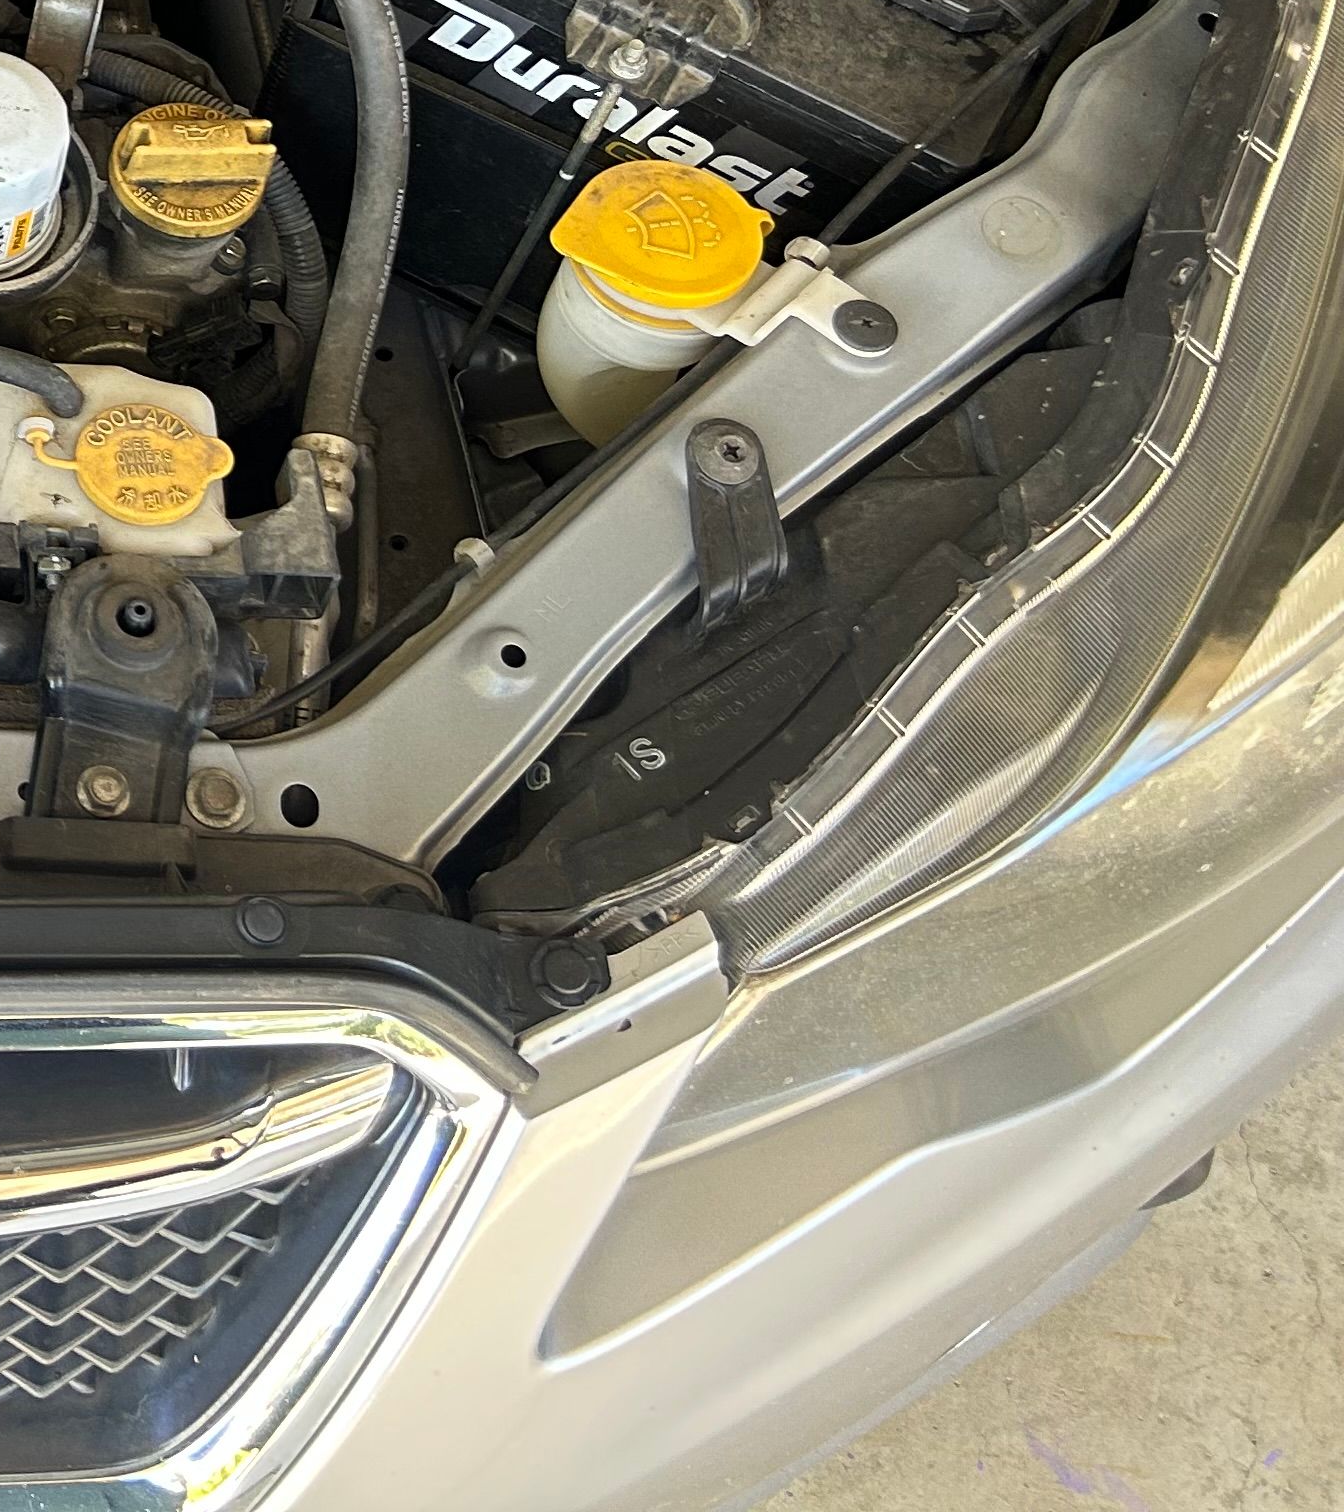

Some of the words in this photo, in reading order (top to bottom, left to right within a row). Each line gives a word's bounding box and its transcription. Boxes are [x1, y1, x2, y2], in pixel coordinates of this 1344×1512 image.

[139, 105, 199, 121] NGINE
[133, 186, 158, 207] SEE
[214, 185, 259, 220] MANUAL
[86, 407, 193, 446] COOLANT
[121, 438, 151, 450] SEE
[116, 449, 172, 465] OWNERS
[118, 464, 175, 478] MANUAL
[613, 738, 666, 782] 1S
